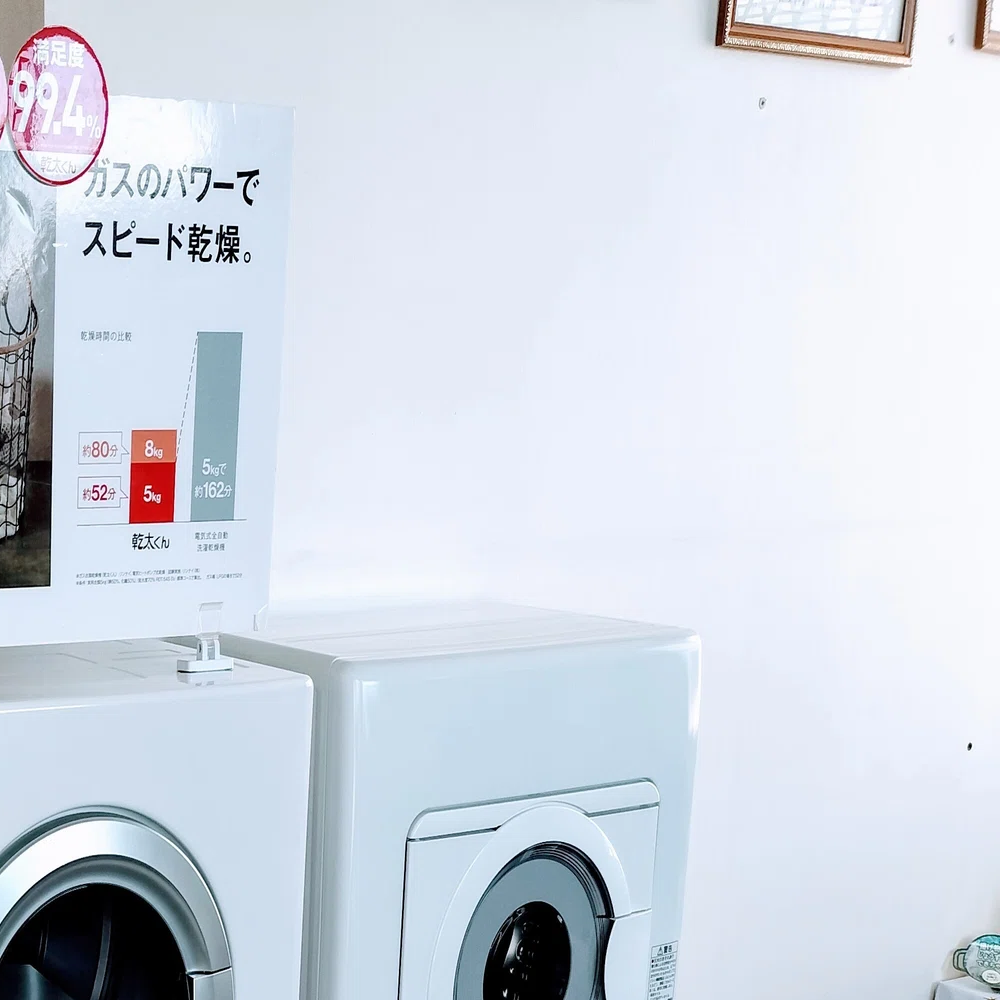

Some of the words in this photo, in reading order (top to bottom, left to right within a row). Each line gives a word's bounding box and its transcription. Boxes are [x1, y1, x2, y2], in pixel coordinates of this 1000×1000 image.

[33, 38, 85, 69] 満足度
[12, 70, 101, 138] 99.4%
[41, 157, 77, 174] 乾太くん
[84, 158, 261, 206] ガスのパワーで
[83, 220, 252, 264] スピード乾燥。
[80, 330, 132, 342] 乾燥時間の比較
[82, 441, 118, 458] 約80分
[144, 440, 163, 459] 8kg
[202, 458, 227, 476] 5kgで
[82, 484, 116, 502] 約52分
[143, 485, 162, 504] 5kg
[194, 481, 232, 499] 約162分
[132, 532, 170, 550] 乾太くん
